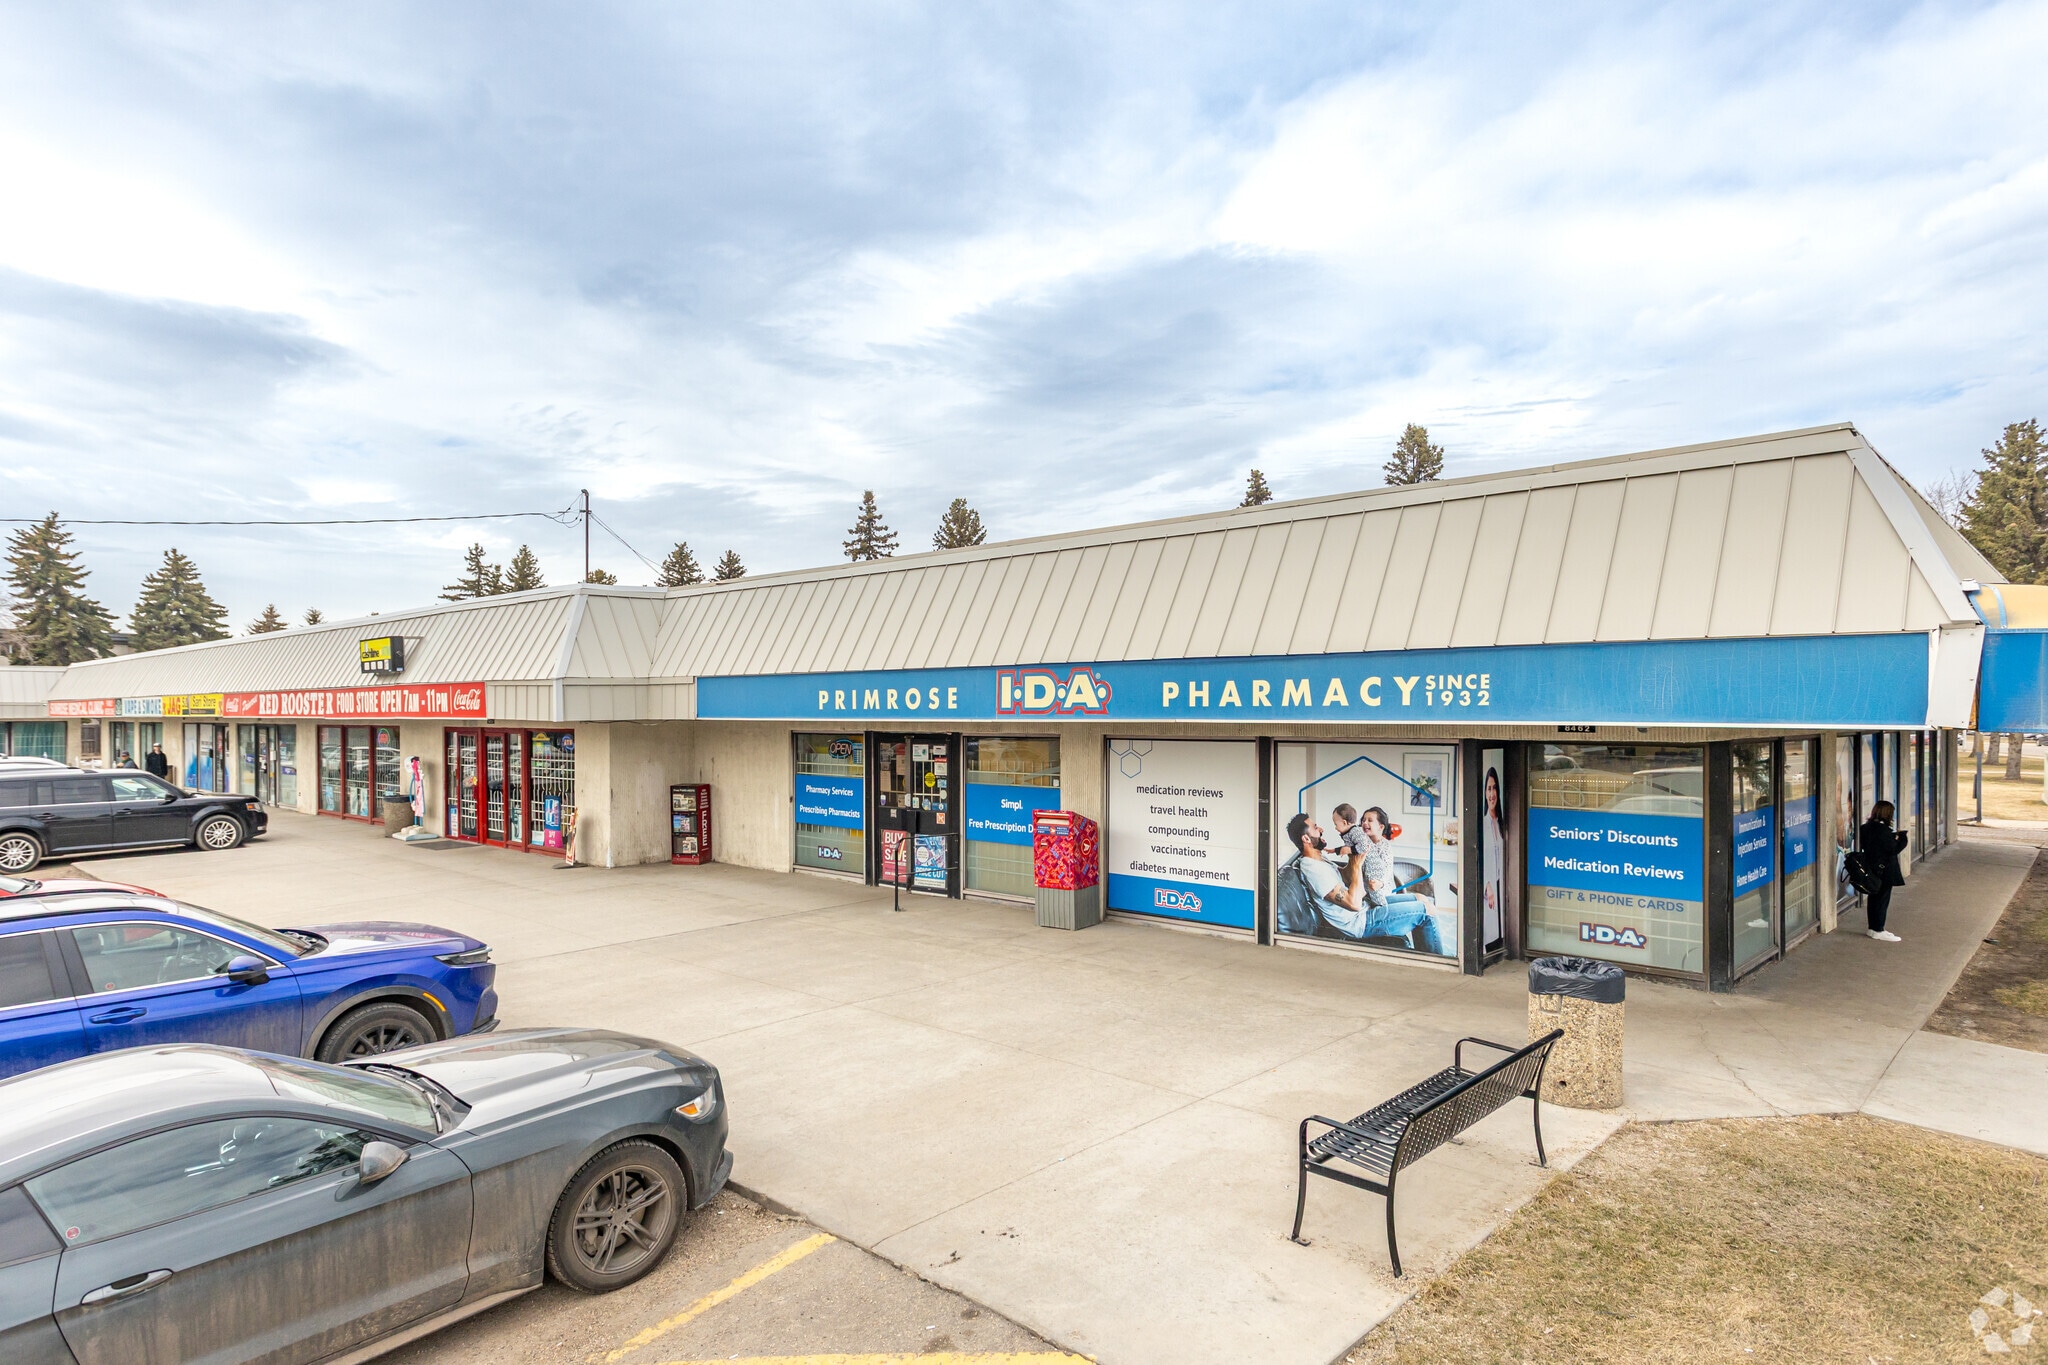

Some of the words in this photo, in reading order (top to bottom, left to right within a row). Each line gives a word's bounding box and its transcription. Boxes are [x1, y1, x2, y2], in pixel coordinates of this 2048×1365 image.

[1425, 674, 1490, 690] SINCE
[818, 687, 958, 710] PRIMROSE
[1162, 675, 1421, 707] PHARMACY
[1425, 690, 1490, 706] 1932
[258, 693, 279, 715] RED
[281, 692, 334, 715] ROOSTER
[336, 692, 354, 713] FOOD
[356, 691, 378, 713] STORE
[380, 690, 402, 713] OPEN
[403, 689, 420, 713] 7AM
[426, 689, 448, 713] 11PM
[829, 743, 852, 755] OPEN
[805, 785, 831, 796] Pharmacy
[831, 786, 854, 797] Services
[1136, 784, 1185, 796] medication
[1187, 787, 1224, 799] reviews
[799, 804, 828, 817] Prescribing
[828, 807, 861, 819] Pharmacists
[1150, 805, 1176, 816] travel
[1178, 806, 1208, 818] health
[968, 818, 984, 829] Free
[984, 820, 1027, 833] Prescription
[1148, 825, 1210, 841] compounding
[884, 831, 904, 845] BUY
[1607, 829, 1679, 847] Discounts
[1151, 845, 1207, 858] vaccinations
[1737, 840, 1753, 858] Injection
[1753, 836, 1767, 850] Services
[932, 869, 945, 878] CUT
[1129, 861, 1167, 874] diabetes
[1169, 866, 1230, 881] management
[1544, 855, 1620, 874] Medication
[1623, 862, 1684, 880] Reviews
[1759, 866, 1767, 878] Care
[1546, 889, 1574, 900] GIFT
[1577, 891, 1586, 902] &
[1589, 893, 1634, 907] PHONE
[1637, 898, 1684, 912] CARDS
